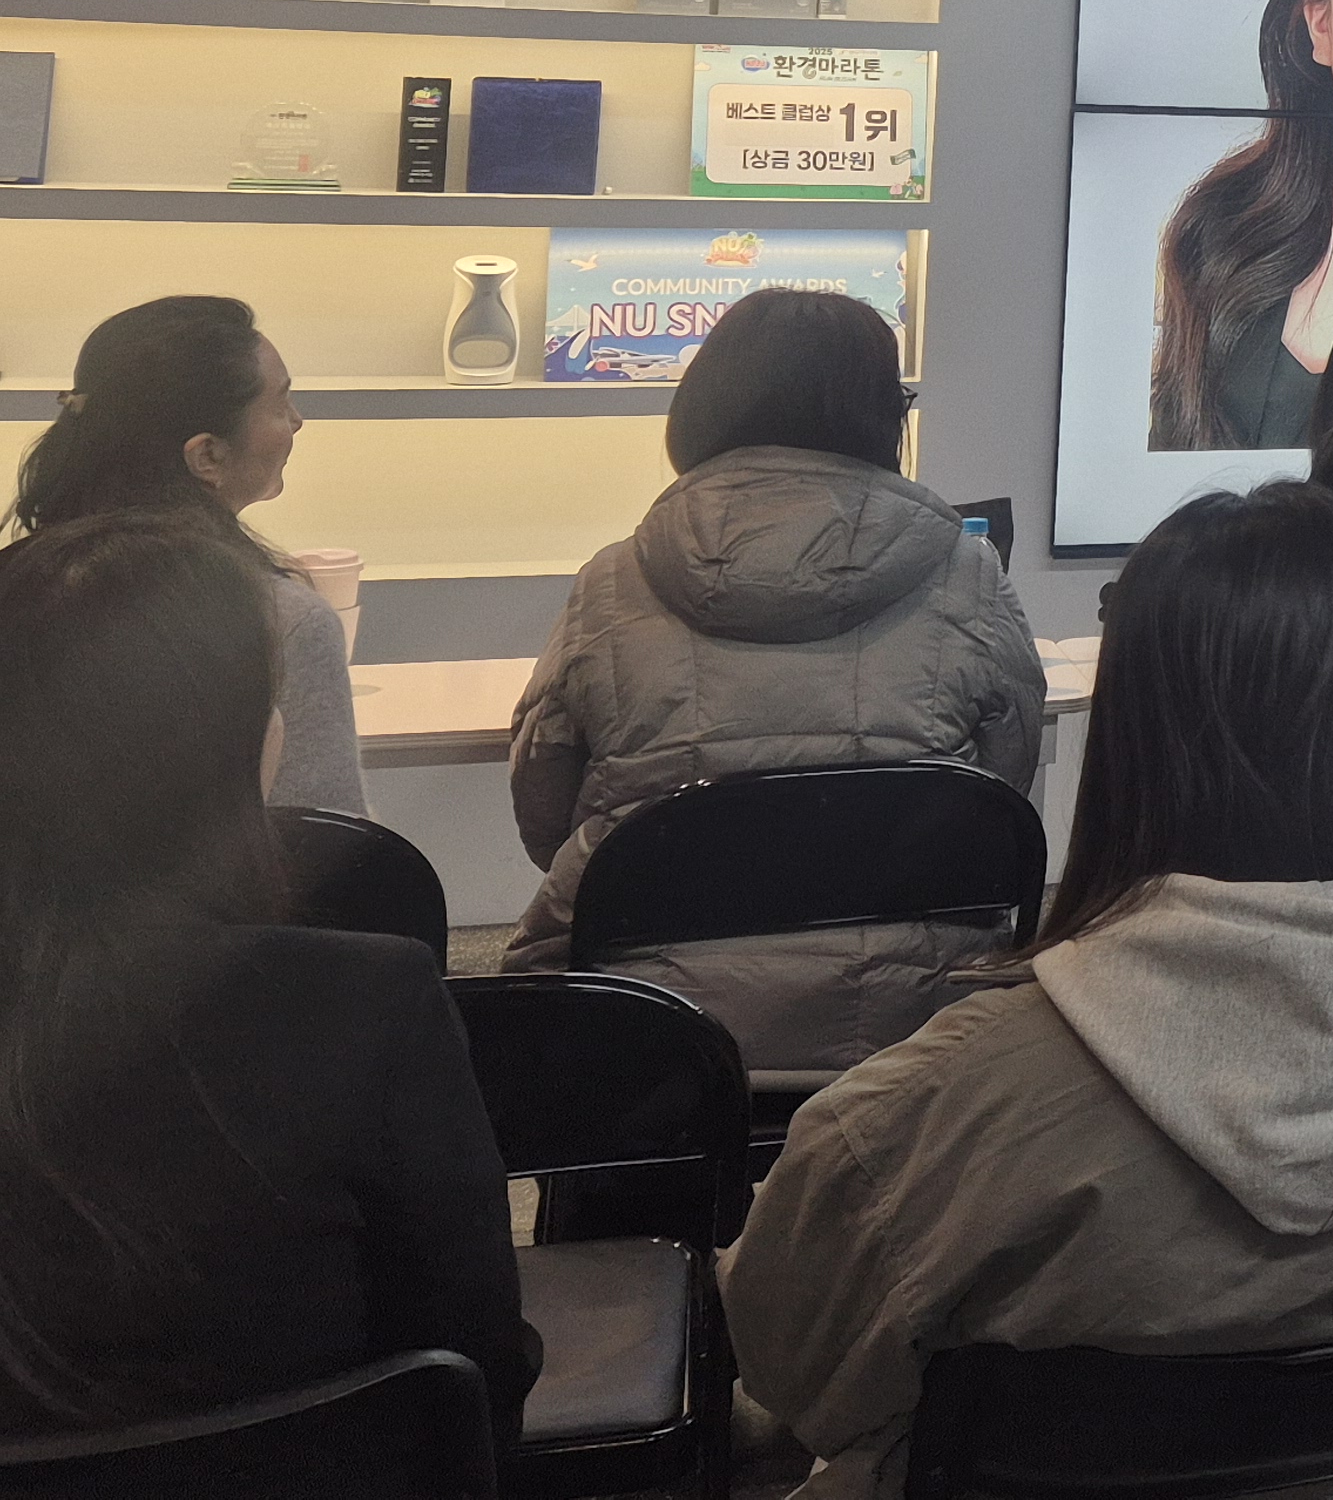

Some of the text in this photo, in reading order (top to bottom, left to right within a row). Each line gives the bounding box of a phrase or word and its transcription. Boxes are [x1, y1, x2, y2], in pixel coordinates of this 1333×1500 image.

[807, 47, 833, 56] 2025
[772, 55, 884, 81] 환경마라톤
[726, 102, 898, 142] 베스트 클럽상 1위
[742, 149, 875, 172] [상금 30만원]
[611, 277, 750, 297] COMMUNITY
[590, 302, 734, 338] NU SN
